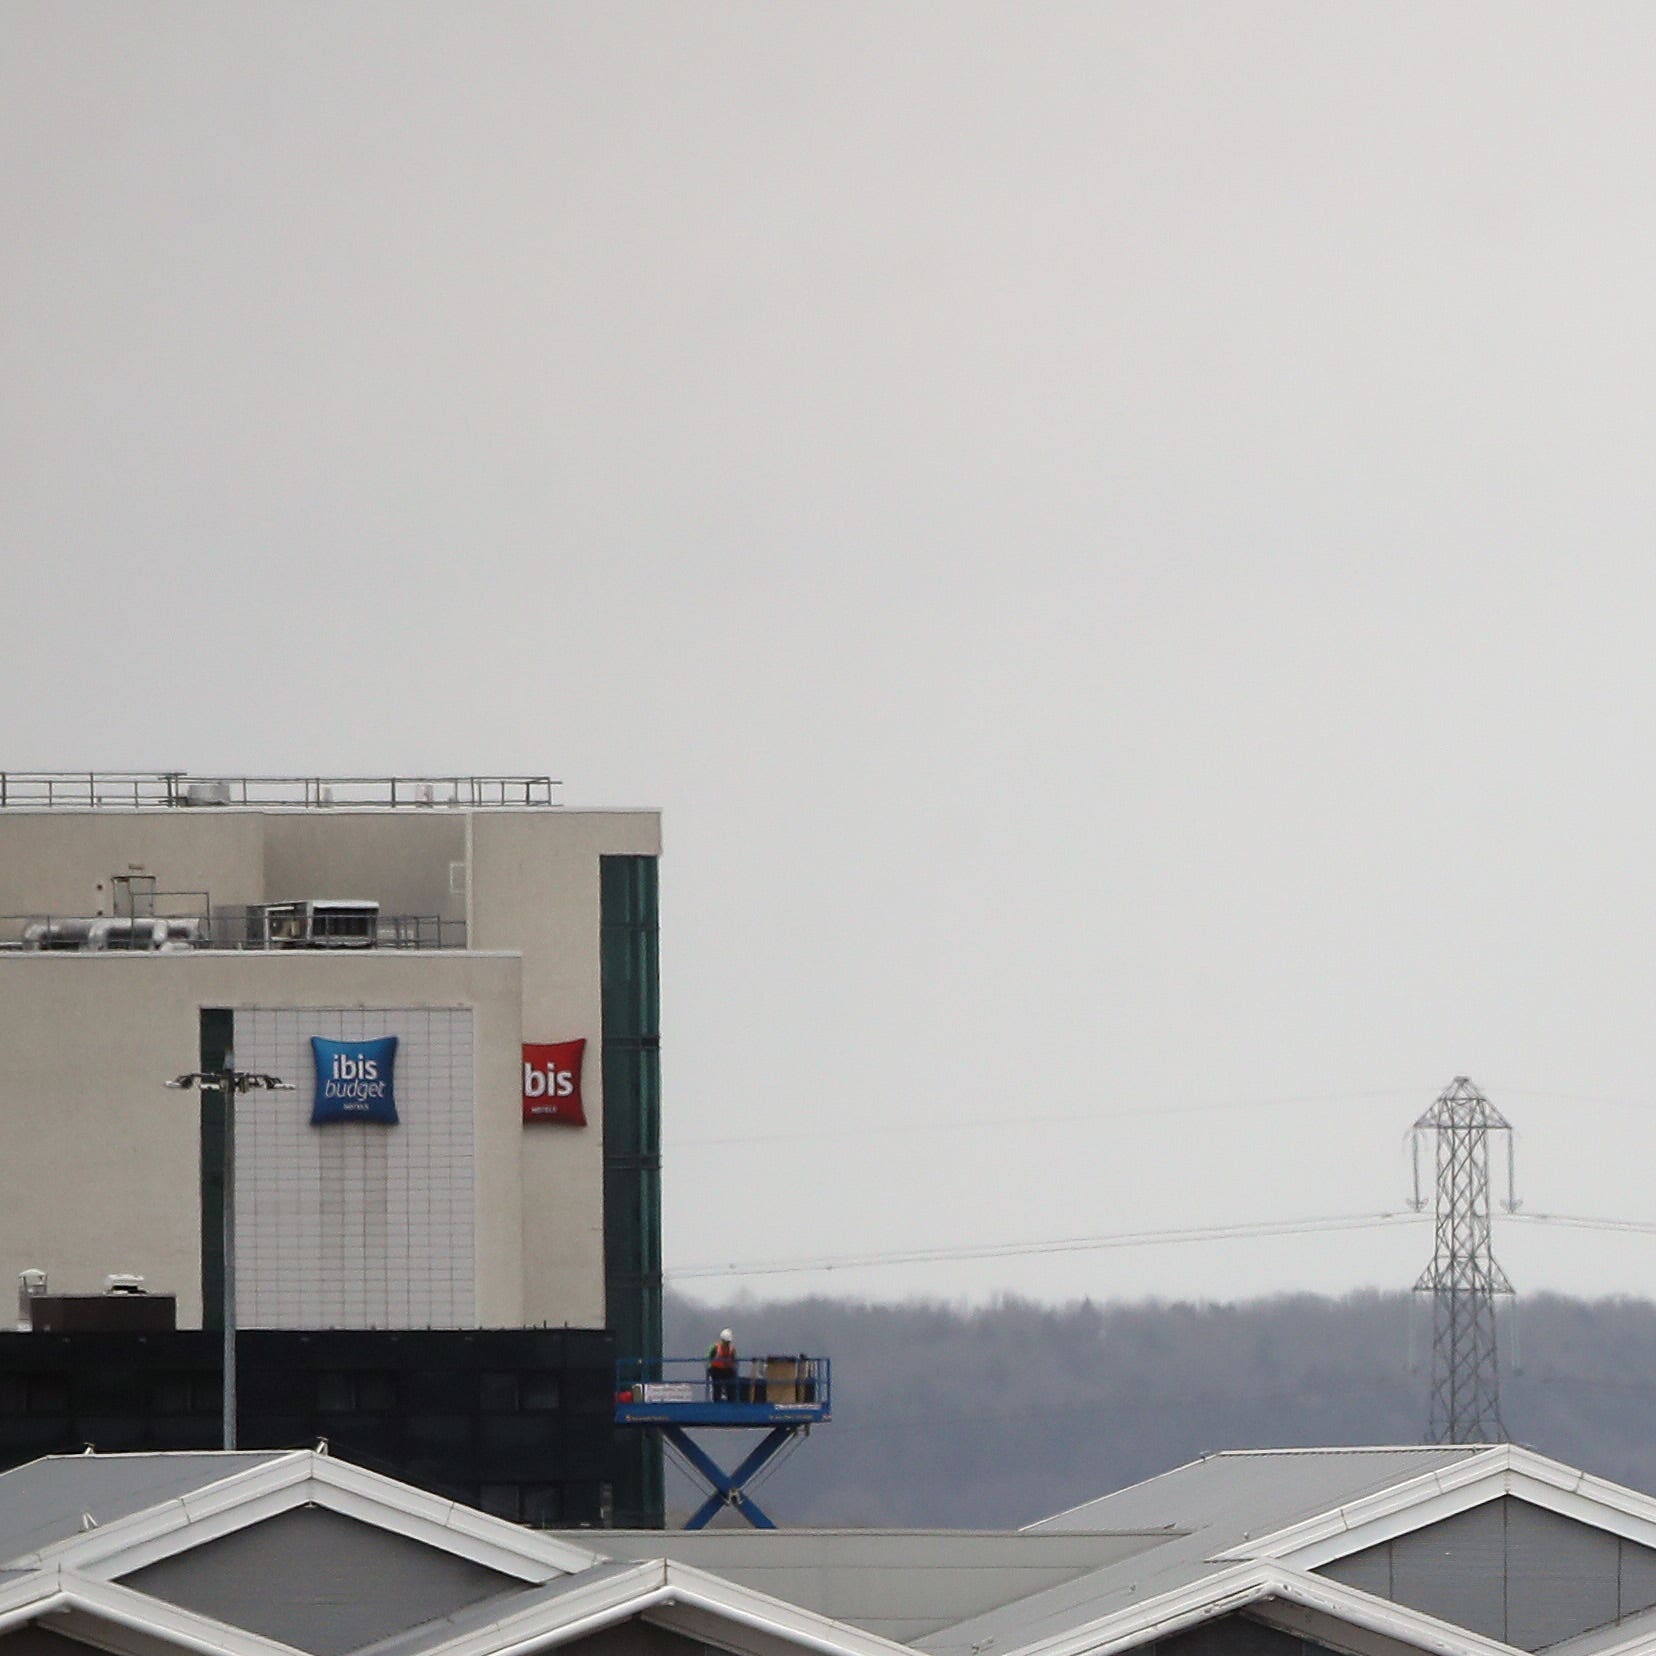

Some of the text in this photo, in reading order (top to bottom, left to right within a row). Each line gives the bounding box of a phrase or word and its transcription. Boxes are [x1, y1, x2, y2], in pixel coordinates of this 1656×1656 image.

[332, 1053, 378, 1080] ibis
[523, 1062, 574, 1098] bis
[325, 1078, 386, 1101] budget
